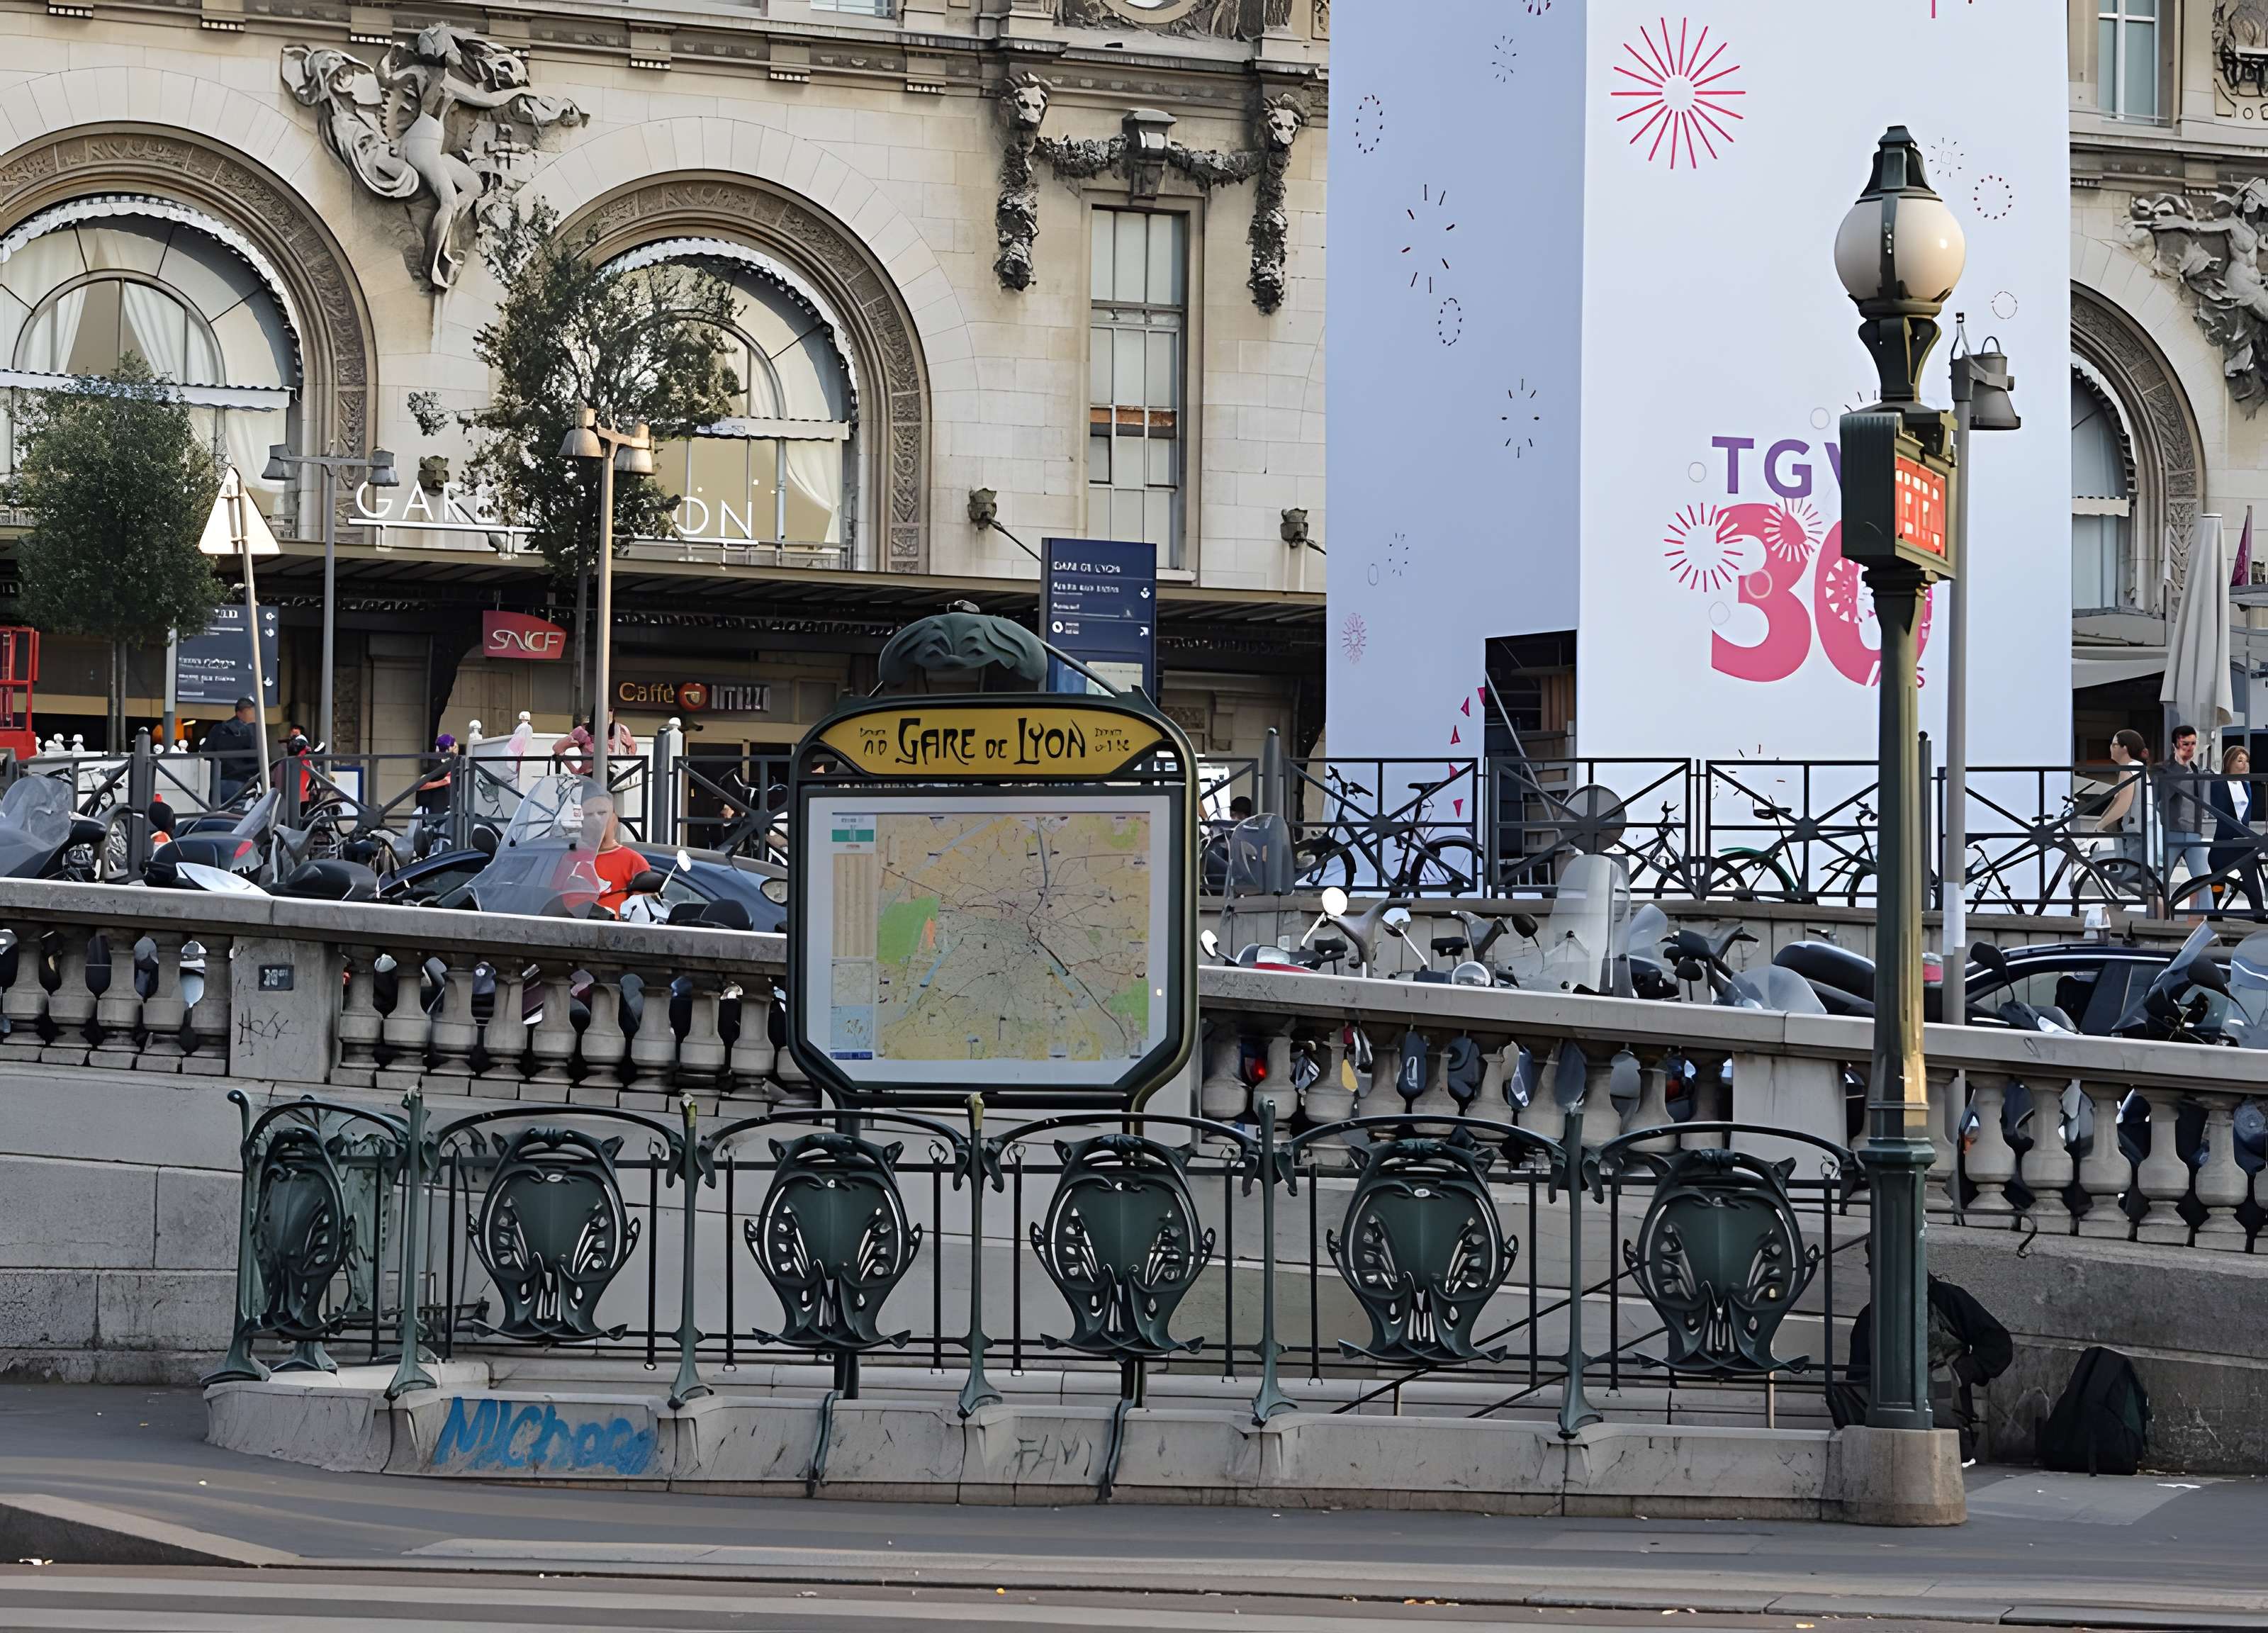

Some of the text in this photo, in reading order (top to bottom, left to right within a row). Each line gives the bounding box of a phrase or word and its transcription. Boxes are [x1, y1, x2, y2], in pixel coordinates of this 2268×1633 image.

[489, 629, 562, 652] SNCF
[895, 718, 975, 765] GARE
[1014, 717, 1086, 765] LYON
